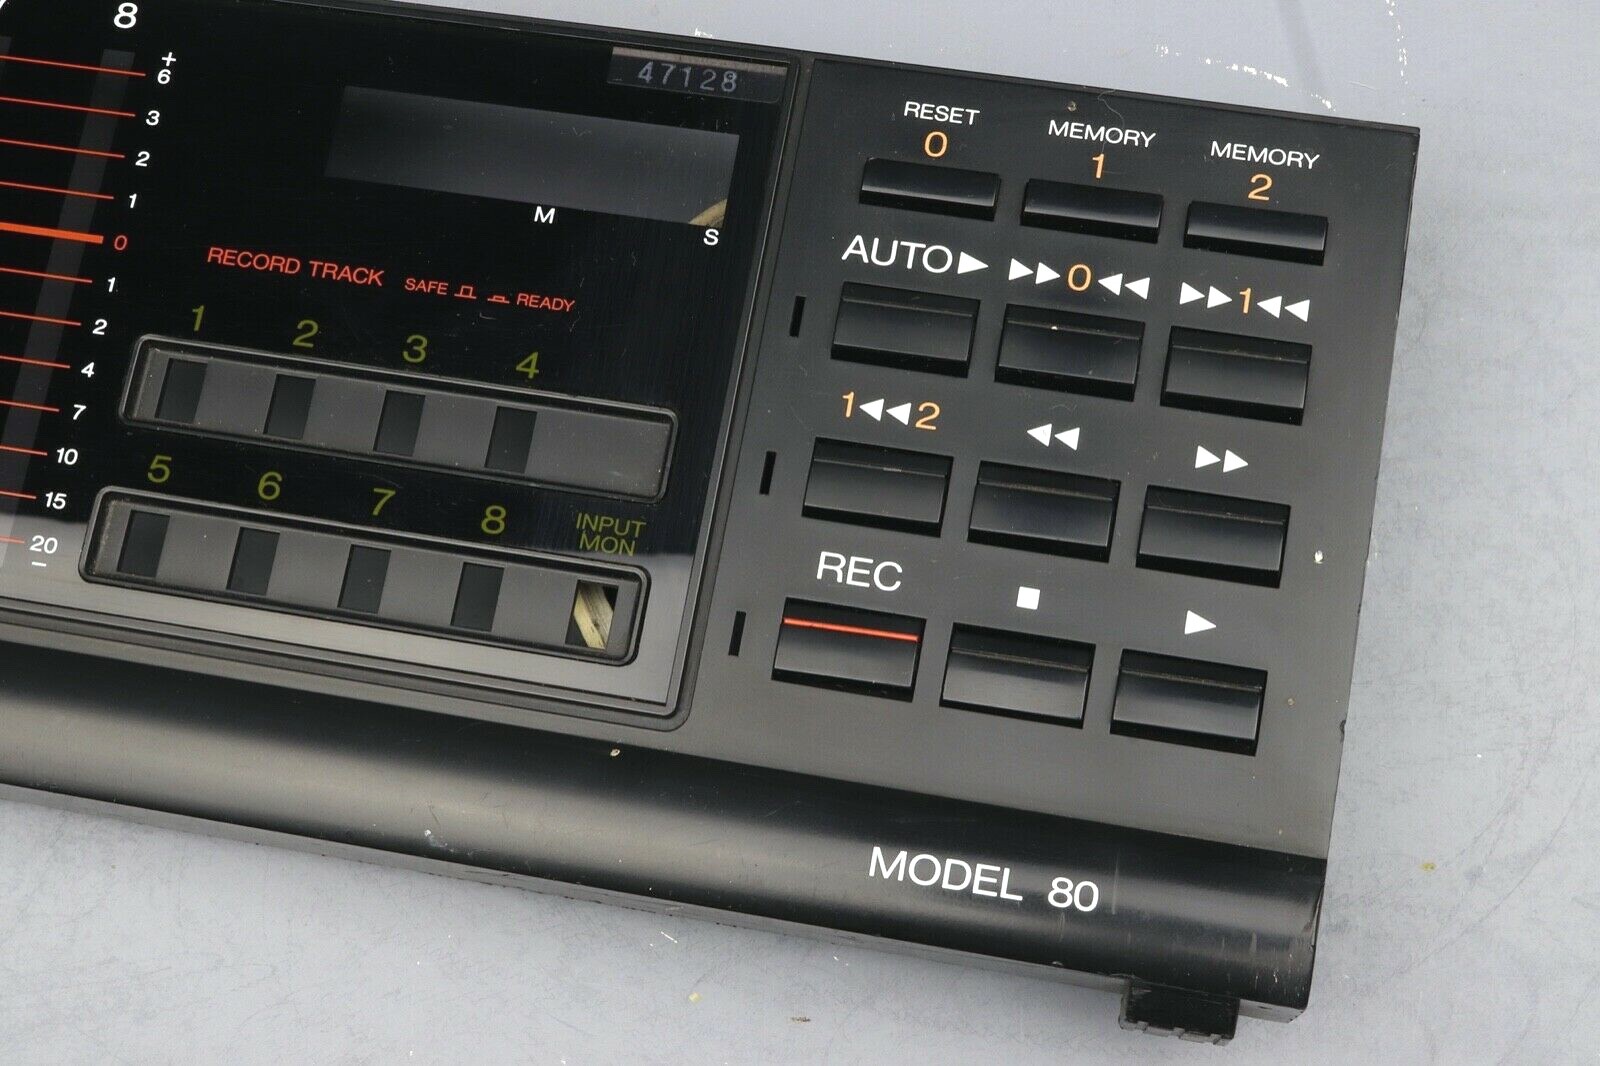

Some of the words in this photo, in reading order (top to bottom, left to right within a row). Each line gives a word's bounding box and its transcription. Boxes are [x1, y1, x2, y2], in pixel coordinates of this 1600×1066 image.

[113, 2, 139, 29] 8
[157, 68, 172, 85] 6
[637, 60, 739, 94] 47128
[145, 109, 161, 126] 3
[903, 100, 981, 126] RESET
[924, 131, 948, 158] 0
[1048, 119, 1157, 148] MEMORY
[135, 150, 151, 167] 2
[1092, 153, 1105, 179] 1
[1210, 140, 1321, 170] MEMORY
[1247, 173, 1273, 201] 2
[129, 193, 137, 209] 1
[533, 205, 556, 224] M
[113, 234, 128, 251] 0
[703, 228, 720, 246] S
[207, 246, 301, 275] RECORD
[309, 260, 385, 287] TRACK
[841, 234, 953, 274] AUTO
[107, 276, 116, 293] 1
[1067, 263, 1092, 292] 0
[404, 277, 449, 296] SAFE
[516, 292, 576, 312] READY
[1239, 287, 1252, 314] 1
[92, 318, 108, 336] 2
[192, 304, 205, 332] 1
[292, 319, 319, 348] 2
[402, 334, 428, 363] 3
[515, 351, 540, 379] 4
[80, 361, 95, 378] 4
[72, 403, 87, 421] 7
[842, 391, 855, 418] 1
[915, 401, 941, 431] 2
[56, 447, 79, 466] 10
[45, 491, 67, 510] 15
[147, 454, 172, 484] 5
[257, 471, 283, 501] 6
[372, 487, 396, 516] 7
[481, 505, 507, 535] 8
[575, 512, 648, 539] INPUT
[29, 534, 59, 555] 20
[577, 532, 637, 558] MON
[816, 550, 903, 592] REC
[868, 846, 1024, 902] MODEL
[1047, 876, 1100, 912] 80
